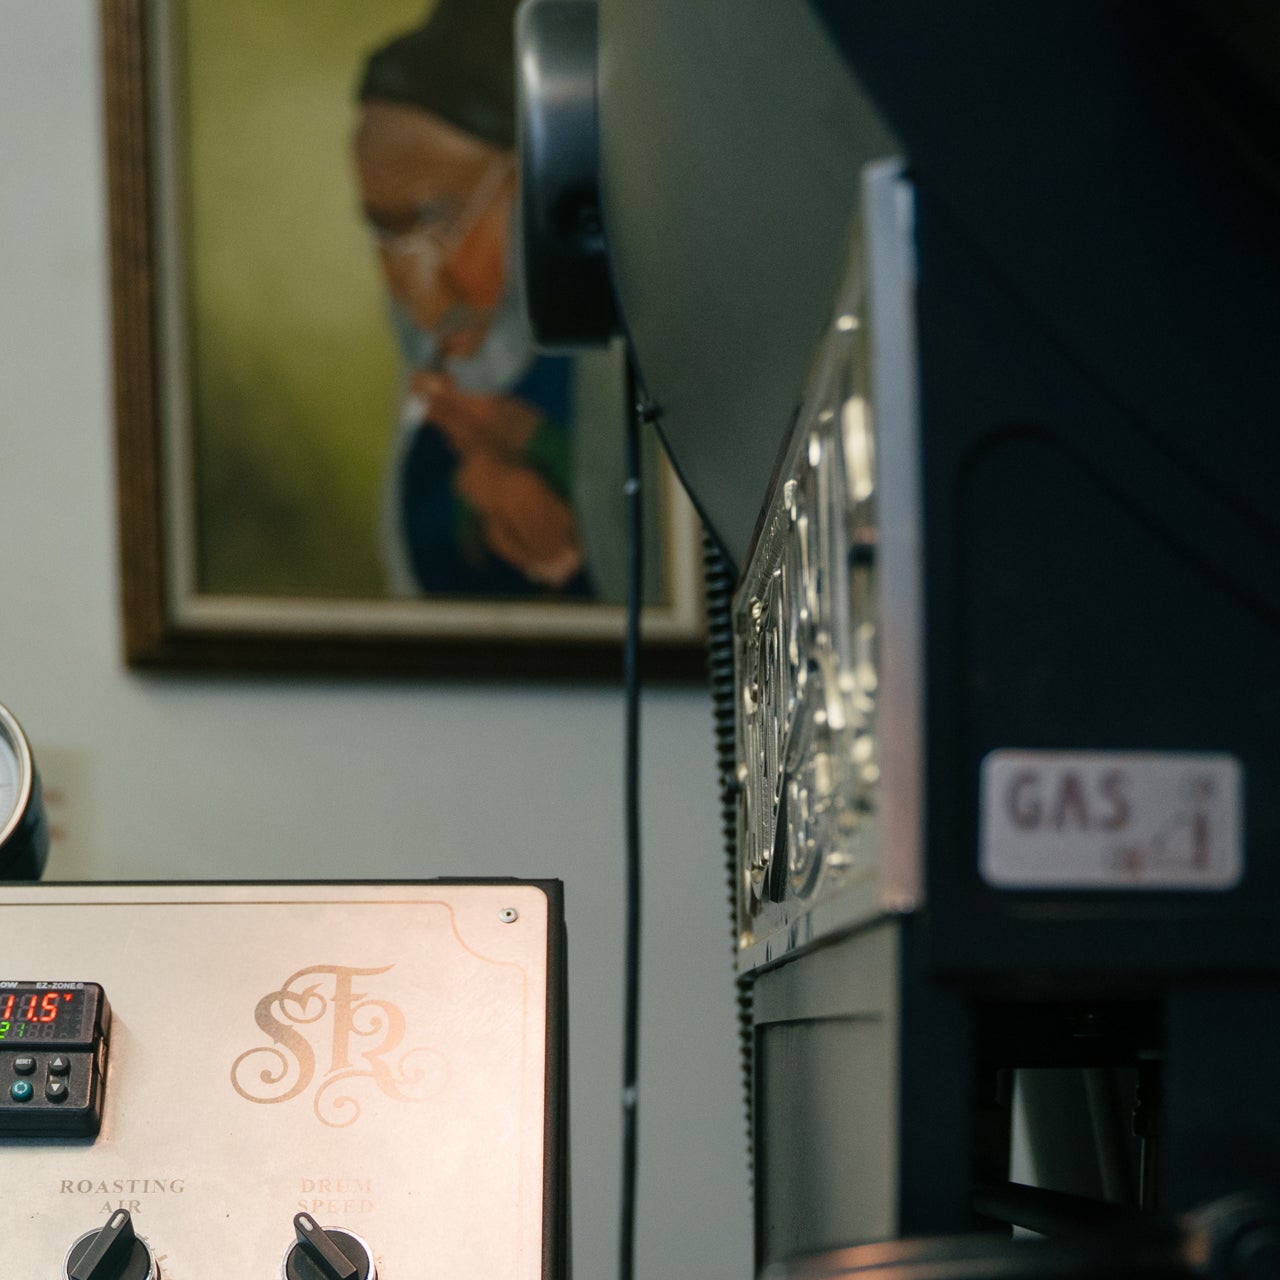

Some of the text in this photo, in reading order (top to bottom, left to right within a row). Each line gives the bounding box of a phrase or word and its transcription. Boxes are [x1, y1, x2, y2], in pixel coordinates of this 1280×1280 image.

[1005, 768, 1131, 831] GAS
[59, 1179, 185, 1194] ROASTING
[99, 1199, 142, 1214] AIR
